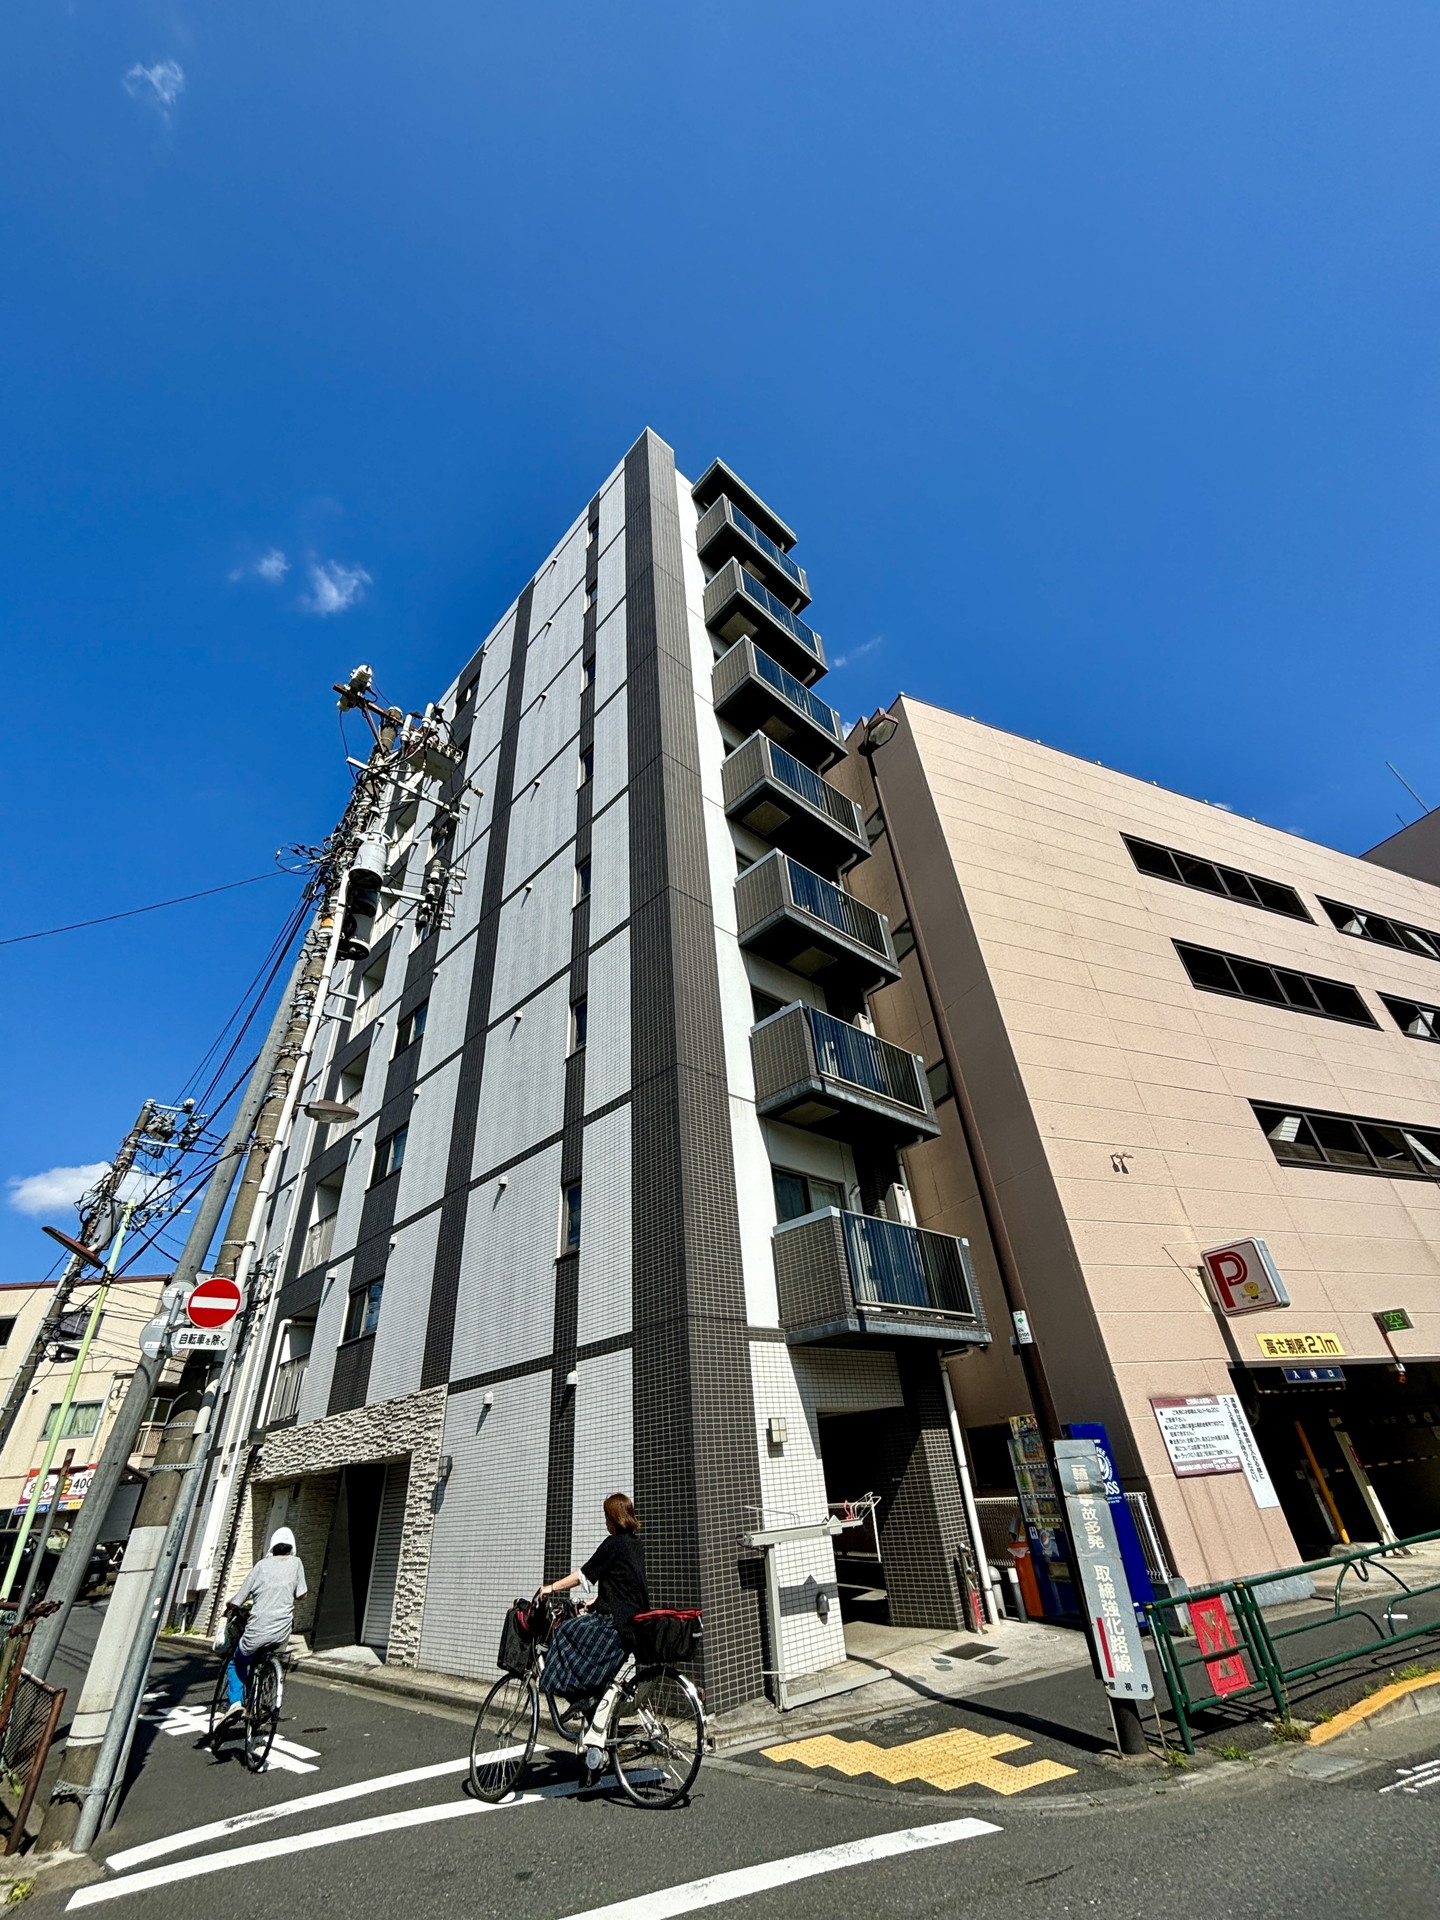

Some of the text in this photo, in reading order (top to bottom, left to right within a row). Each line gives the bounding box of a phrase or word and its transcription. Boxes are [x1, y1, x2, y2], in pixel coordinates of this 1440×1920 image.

[1208, 1250, 1248, 1309] P
[178, 1333, 227, 1347] 自転車を除く
[1383, 1312, 1407, 1331] 空
[1093, 1565, 1134, 1673] 取締強化路線
